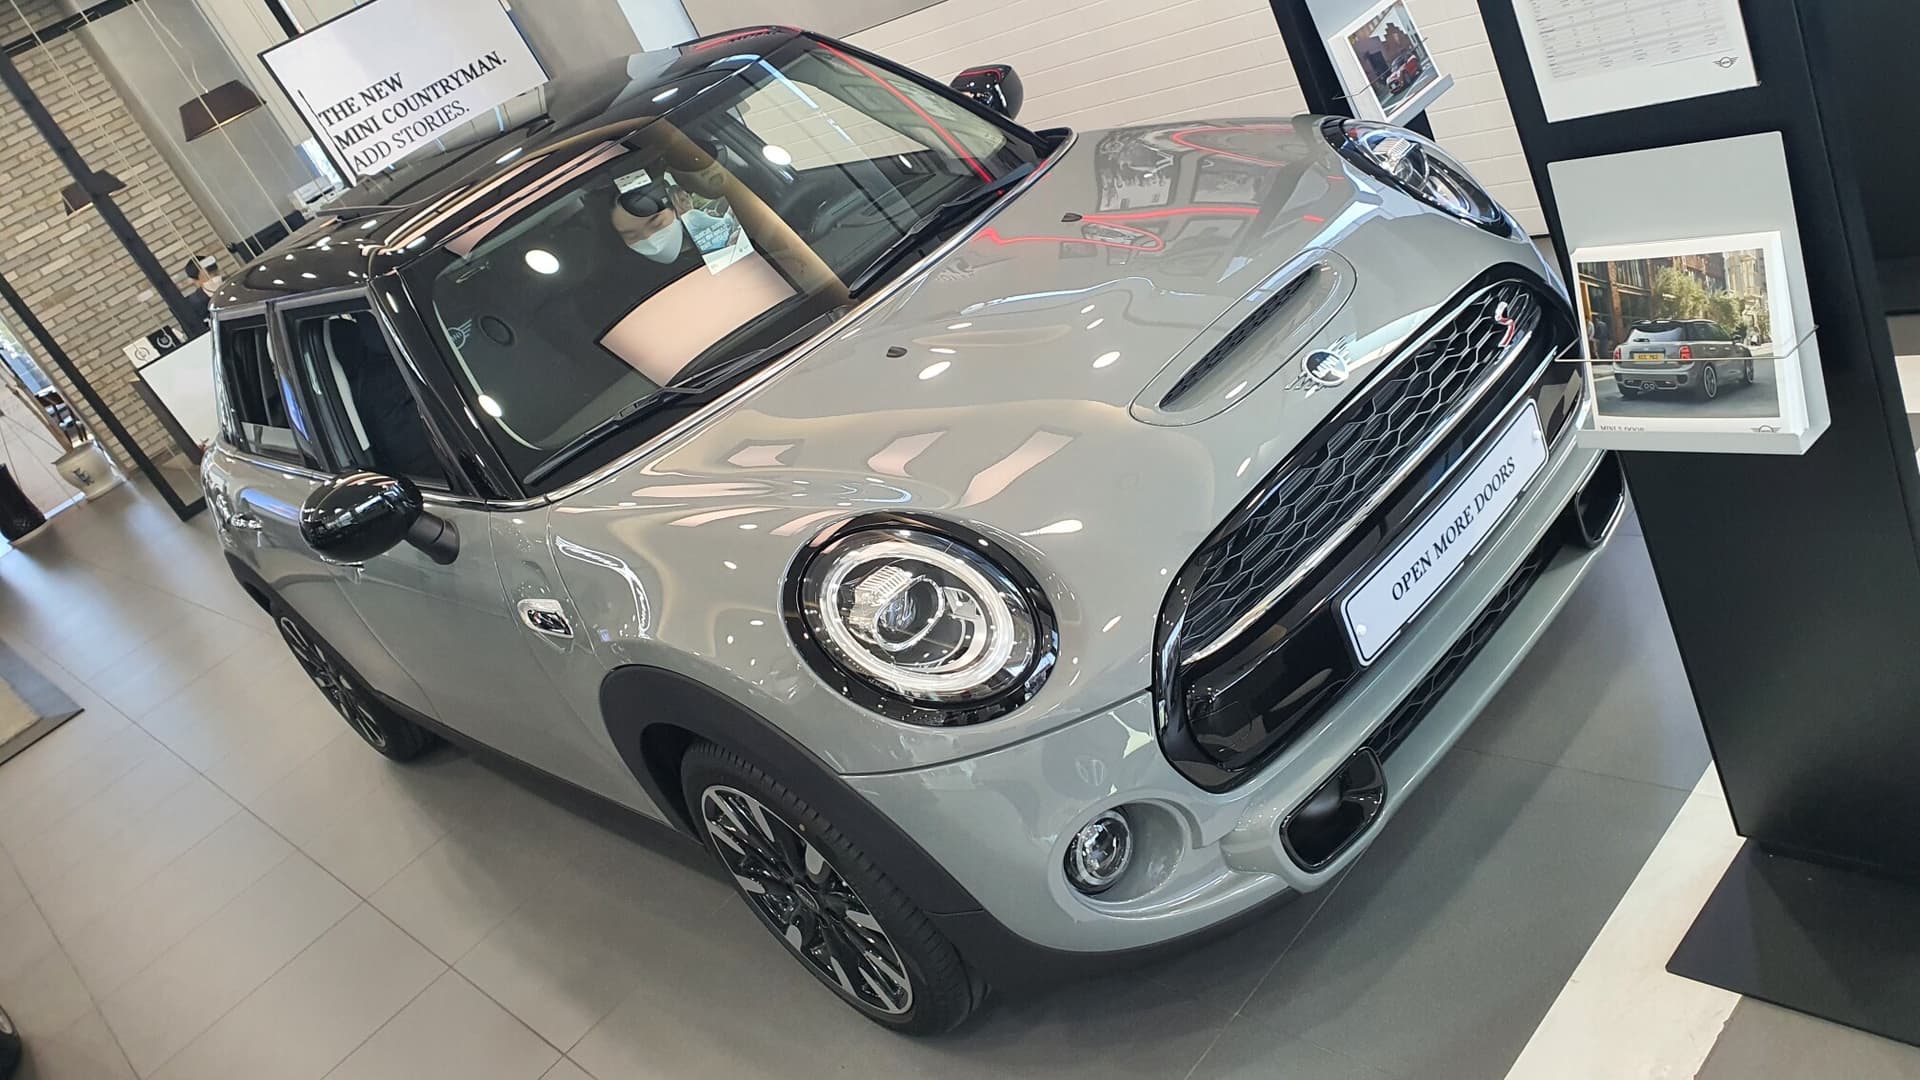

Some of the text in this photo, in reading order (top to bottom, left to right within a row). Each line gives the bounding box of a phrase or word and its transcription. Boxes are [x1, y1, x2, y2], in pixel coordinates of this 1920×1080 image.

[319, 72, 404, 127] THE NEW
[334, 51, 507, 150] MINI COUNTRYMAN.
[352, 100, 470, 172] ADD STORIES.
[1391, 456, 1516, 601] OPEN MORE DOORS
